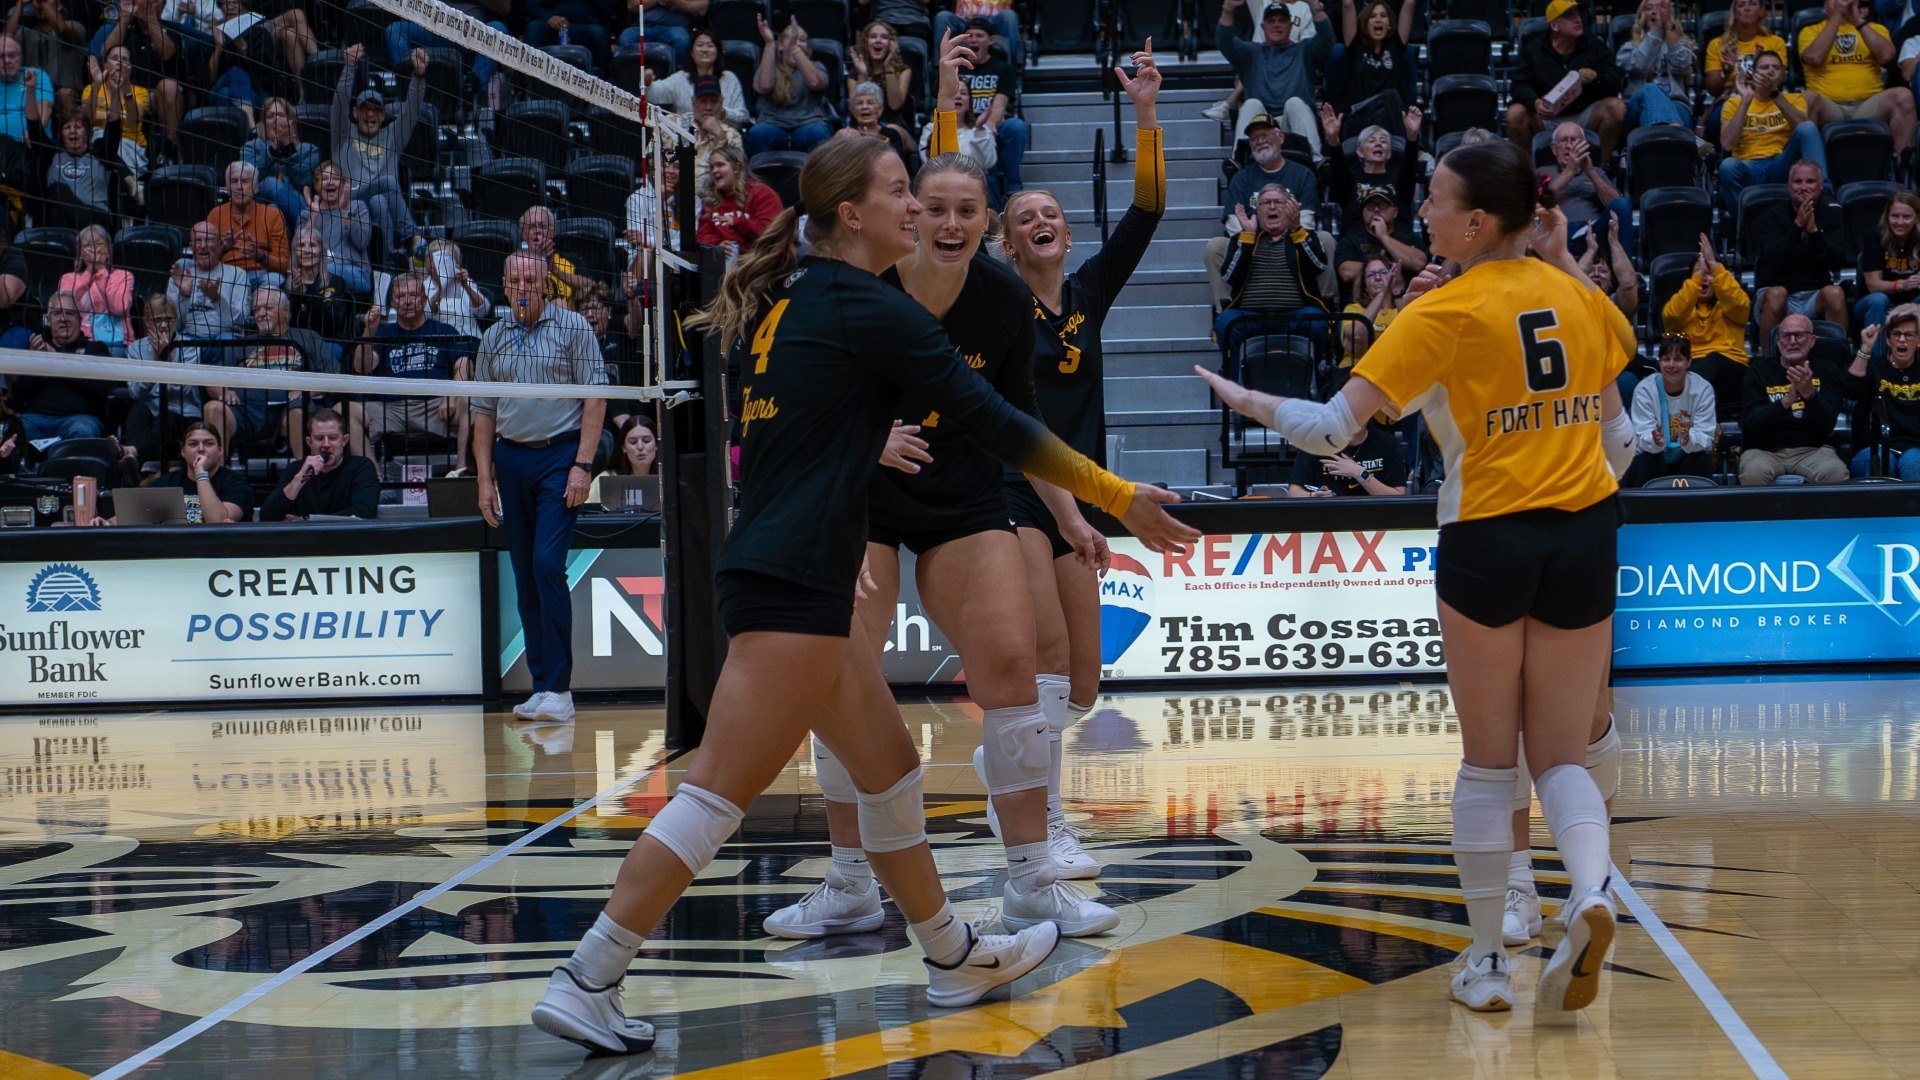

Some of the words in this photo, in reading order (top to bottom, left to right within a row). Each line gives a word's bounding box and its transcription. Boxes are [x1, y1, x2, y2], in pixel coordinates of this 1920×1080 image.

[751, 299, 790, 374] 4
[1516, 308, 1569, 394] 6
[1486, 401, 1544, 437] FORT
[1553, 394, 1600, 427] HAYS
[208, 566, 416, 597] CREATING
[1185, 583, 1212, 591] Each
[1214, 581, 1246, 591] Office
[1248, 581, 1258, 589] is
[1260, 579, 1340, 589] Independently
[1343, 579, 1381, 587] Owned
[1383, 577, 1405, 586] and
[1616, 561, 1820, 597] DIAMOND
[0, 620, 145, 651] Sunflower
[186, 609, 445, 642] POSSIBILITY
[1160, 615, 1254, 642] Tim
[1630, 616, 1740, 630] DIAMOND
[1758, 614, 1848, 628] BROKER
[28, 652, 108, 683] Bank
[209, 671, 421, 689] SunflowerBank.com
[38, 691, 75, 699] MEMBER
[78, 690, 98, 698] FDIC
